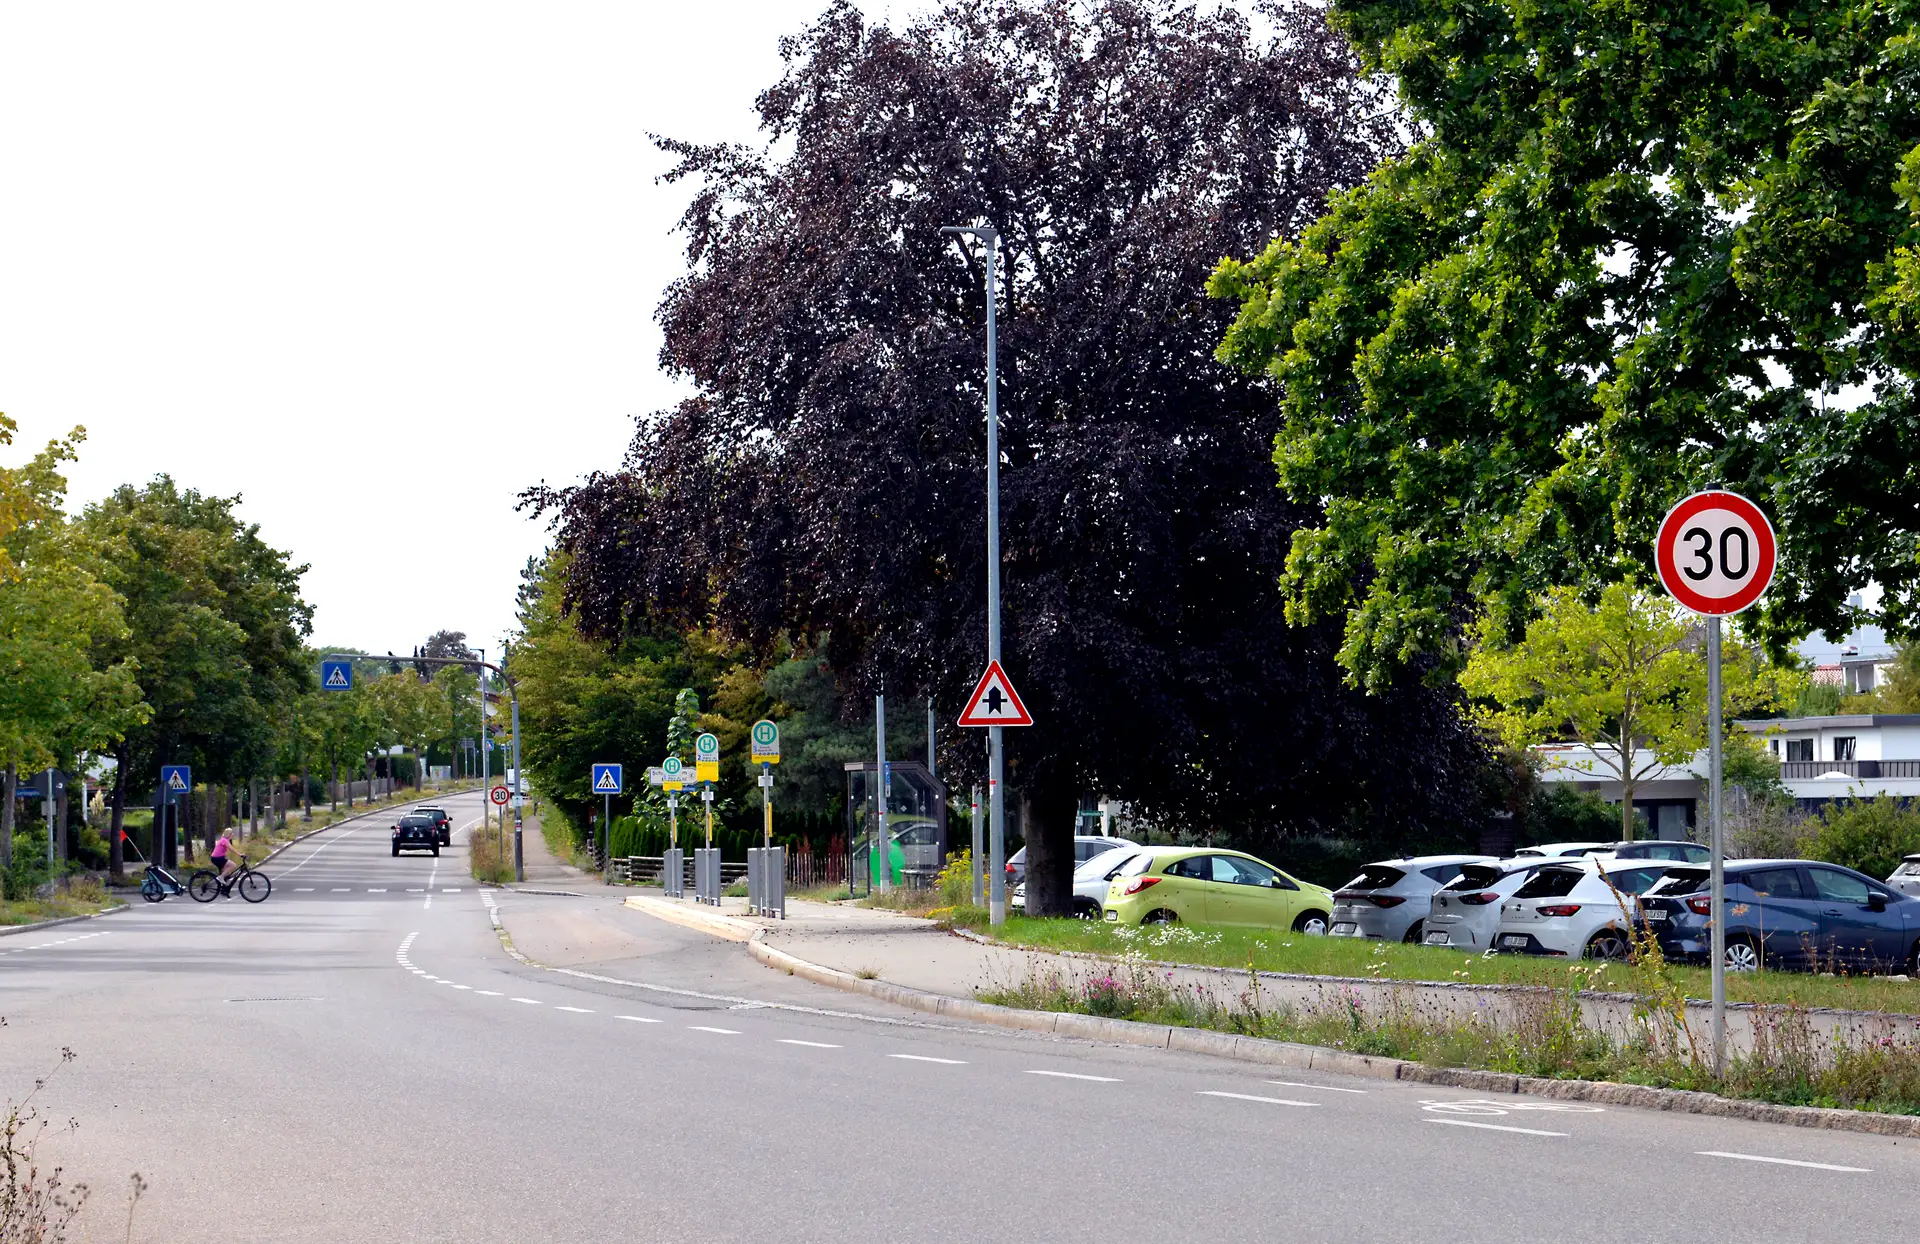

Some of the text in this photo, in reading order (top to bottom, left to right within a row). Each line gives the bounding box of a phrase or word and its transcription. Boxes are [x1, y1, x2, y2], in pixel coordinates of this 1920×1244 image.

[1683, 526, 1749, 581] 30
[760, 726, 770, 740] H
[703, 738, 712, 750] H
[668, 761, 676, 772] H
[495, 791, 506, 800] 30
